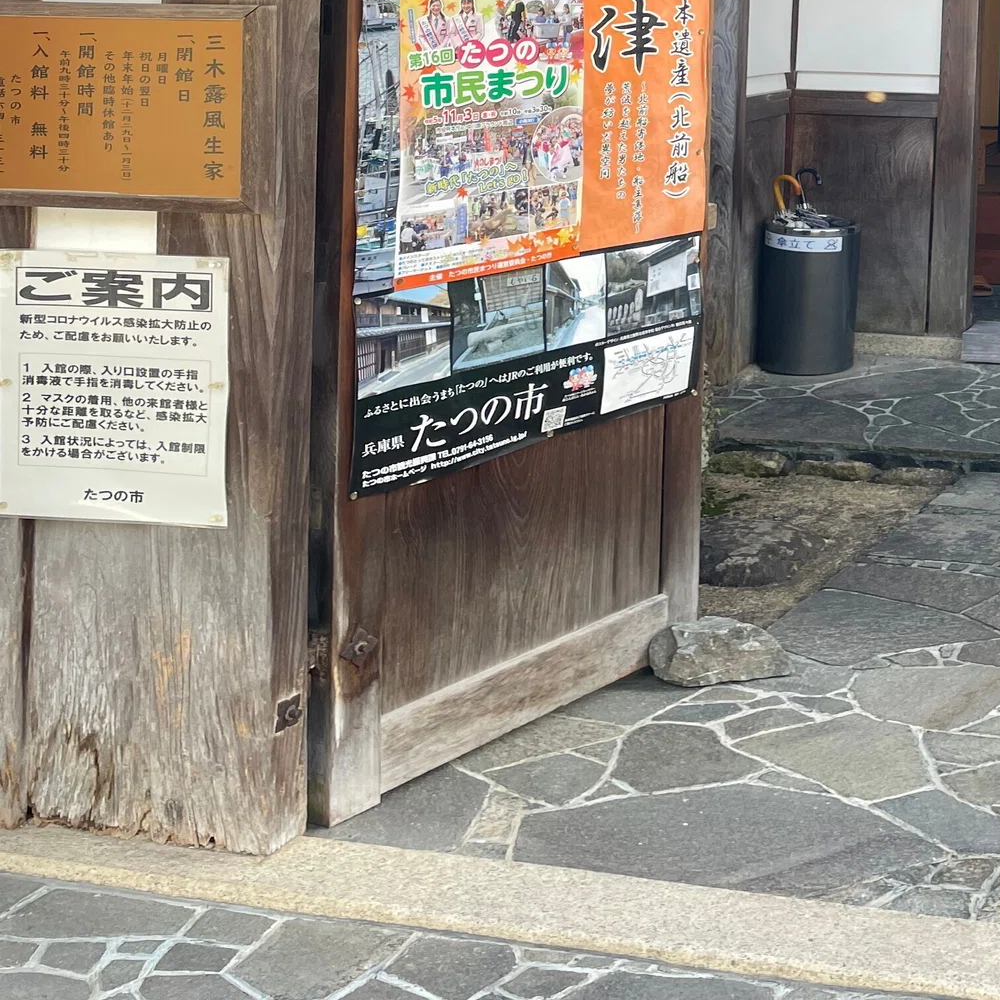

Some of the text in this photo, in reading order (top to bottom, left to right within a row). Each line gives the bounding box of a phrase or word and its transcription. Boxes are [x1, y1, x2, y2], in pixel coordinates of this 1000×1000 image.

[409, 41, 537, 69] 第16回 たつの
[156, 52, 169, 85] 月曜日
[139, 51, 153, 107] 祝日の翌日
[421, 66, 569, 107] 市民まつり
[10, 74, 22, 125] たつの市
[102, 51, 116, 153] その他臨時休館あり
[202, 34, 226, 181] 三木露風生家
[19, 270, 210, 311] ご案内
[19, 313, 212, 331] 新型コロナウイルス感染拡大防止の
[19, 330, 197, 347] ため、ご配慮をお願いいたします。
[41, 363, 199, 380] 入館の際、入り口設置の手指
[22, 375, 204, 393] 消毒液で手指を消毒してください。
[41, 393, 208, 411] マスクの着用、他の来館者様と
[22, 406, 208, 424] 十分な距離を取るなど、感染拡大
[362, 383, 548, 457] 兵庫県 たつの市
[22, 418, 145, 432] 予防にご配慮ください。
[41, 435, 206, 454] 入館状況によっては、入館制限
[21, 448, 165, 464] をかける場合がございます。
[84, 488, 144, 503] たつの市
